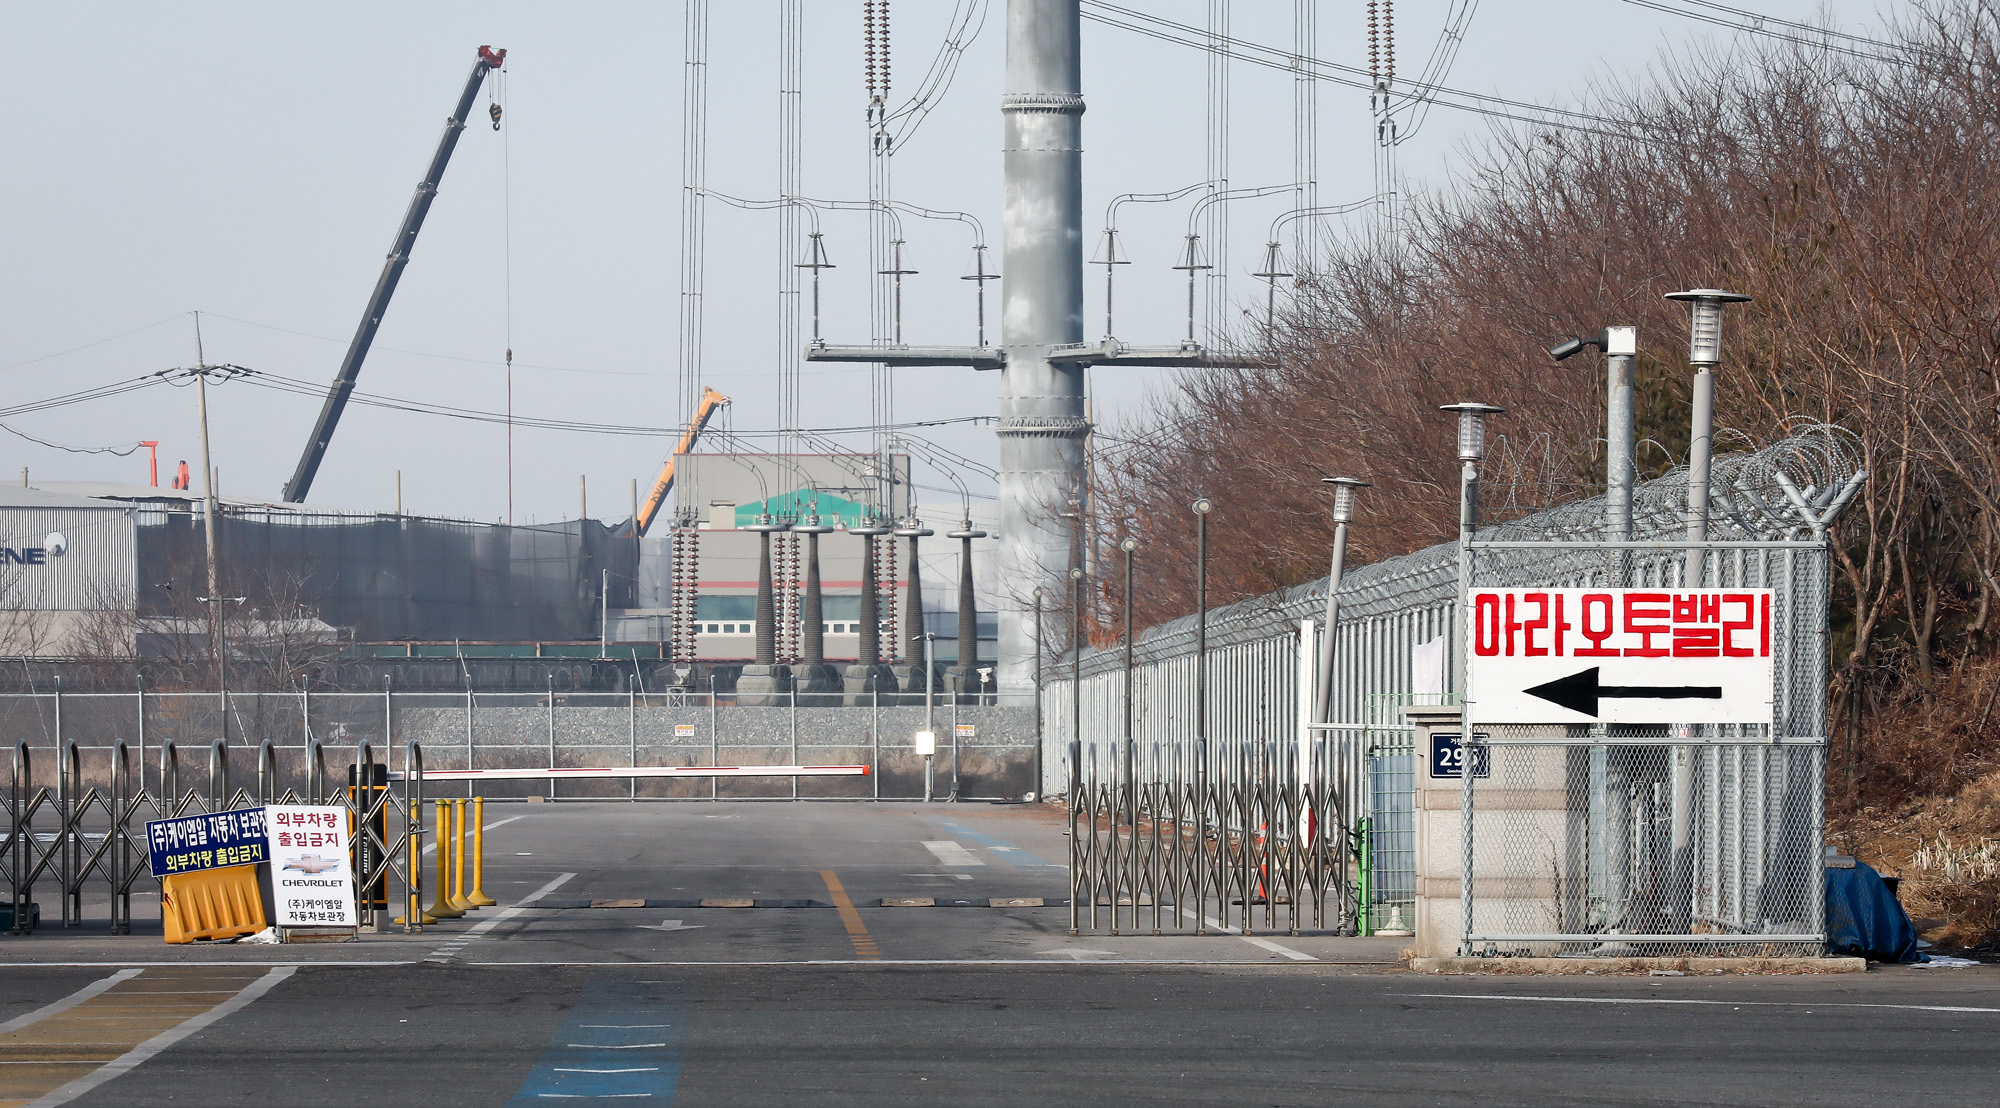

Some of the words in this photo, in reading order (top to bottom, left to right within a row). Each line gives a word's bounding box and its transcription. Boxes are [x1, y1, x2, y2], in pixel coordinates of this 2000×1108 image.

[0, 547, 45, 565] NE
[1475, 593, 1770, 657] 아라오토밸리
[276, 812, 338, 829] 외부차량
[150, 817, 208, 853] (주)케이엠알
[208, 813, 239, 843] 자동차
[278, 832, 339, 848] 출입금지
[166, 849, 213, 871] 외부차량
[216, 843, 263, 865] 출입금지
[282, 879, 344, 887] CHEVROLET
[287, 898, 344, 910] (주)케이엠알
[289, 911, 345, 922] 자동차보관장
